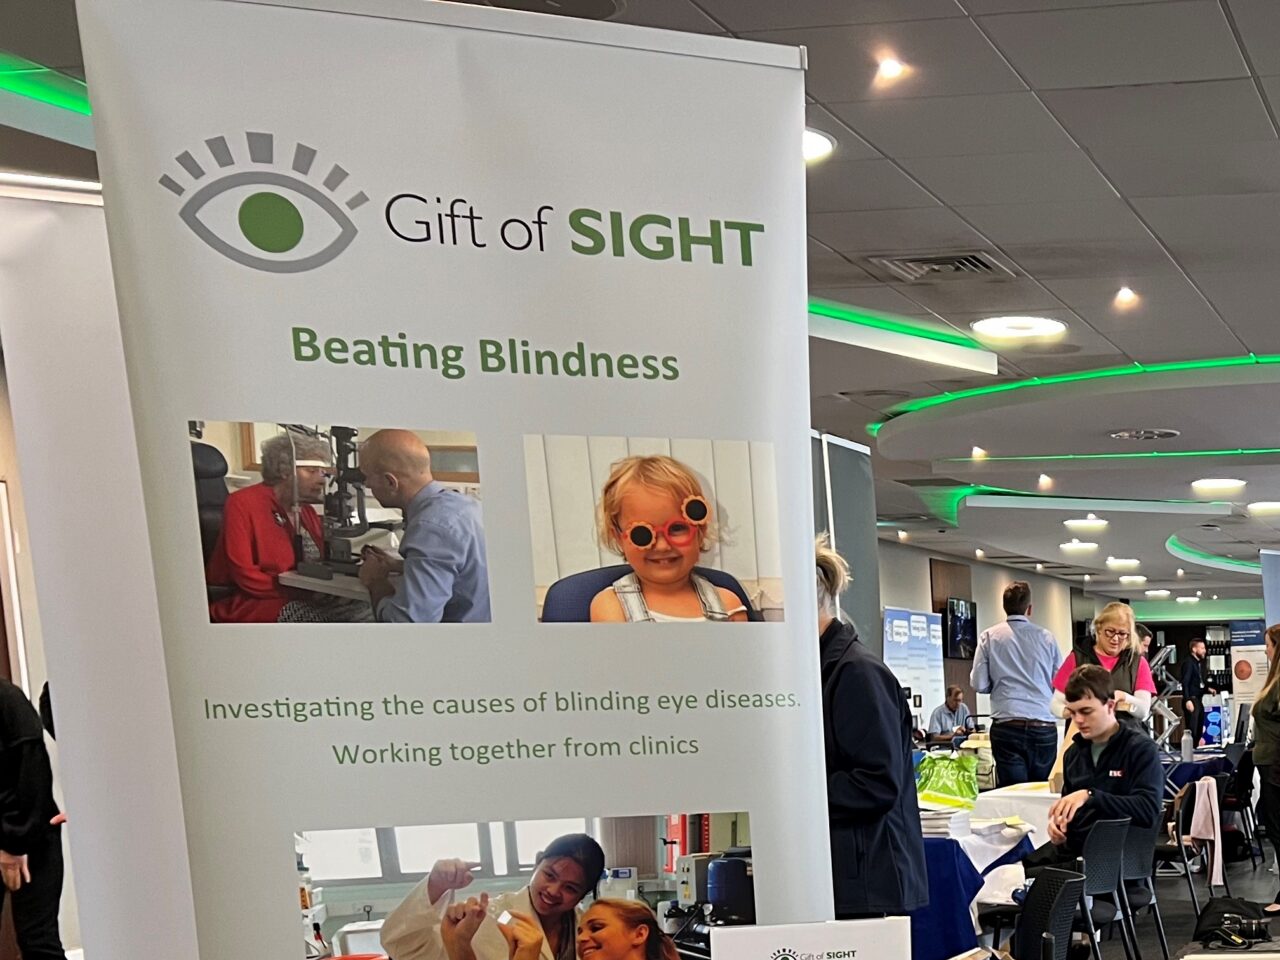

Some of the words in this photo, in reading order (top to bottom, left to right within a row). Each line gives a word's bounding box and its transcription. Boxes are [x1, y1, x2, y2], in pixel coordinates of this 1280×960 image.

[385, 194, 487, 248] Gift
[500, 206, 554, 252] of
[569, 208, 764, 267] SIGHT
[292, 326, 465, 379] Beating
[480, 340, 680, 381] Blindness
[204, 696, 375, 722] Investigating
[382, 694, 425, 716] the
[433, 697, 516, 715] causes
[523, 690, 548, 713] of
[555, 690, 650, 714] blinding
[656, 693, 698, 711] eye
[705, 688, 800, 710] diseases.
[333, 741, 442, 766] Working
[450, 738, 556, 763] together
[564, 736, 620, 758] from
[629, 735, 699, 756] clinics
[816, 952, 824, 960] of
[826, 950, 857, 960] SIGHT
